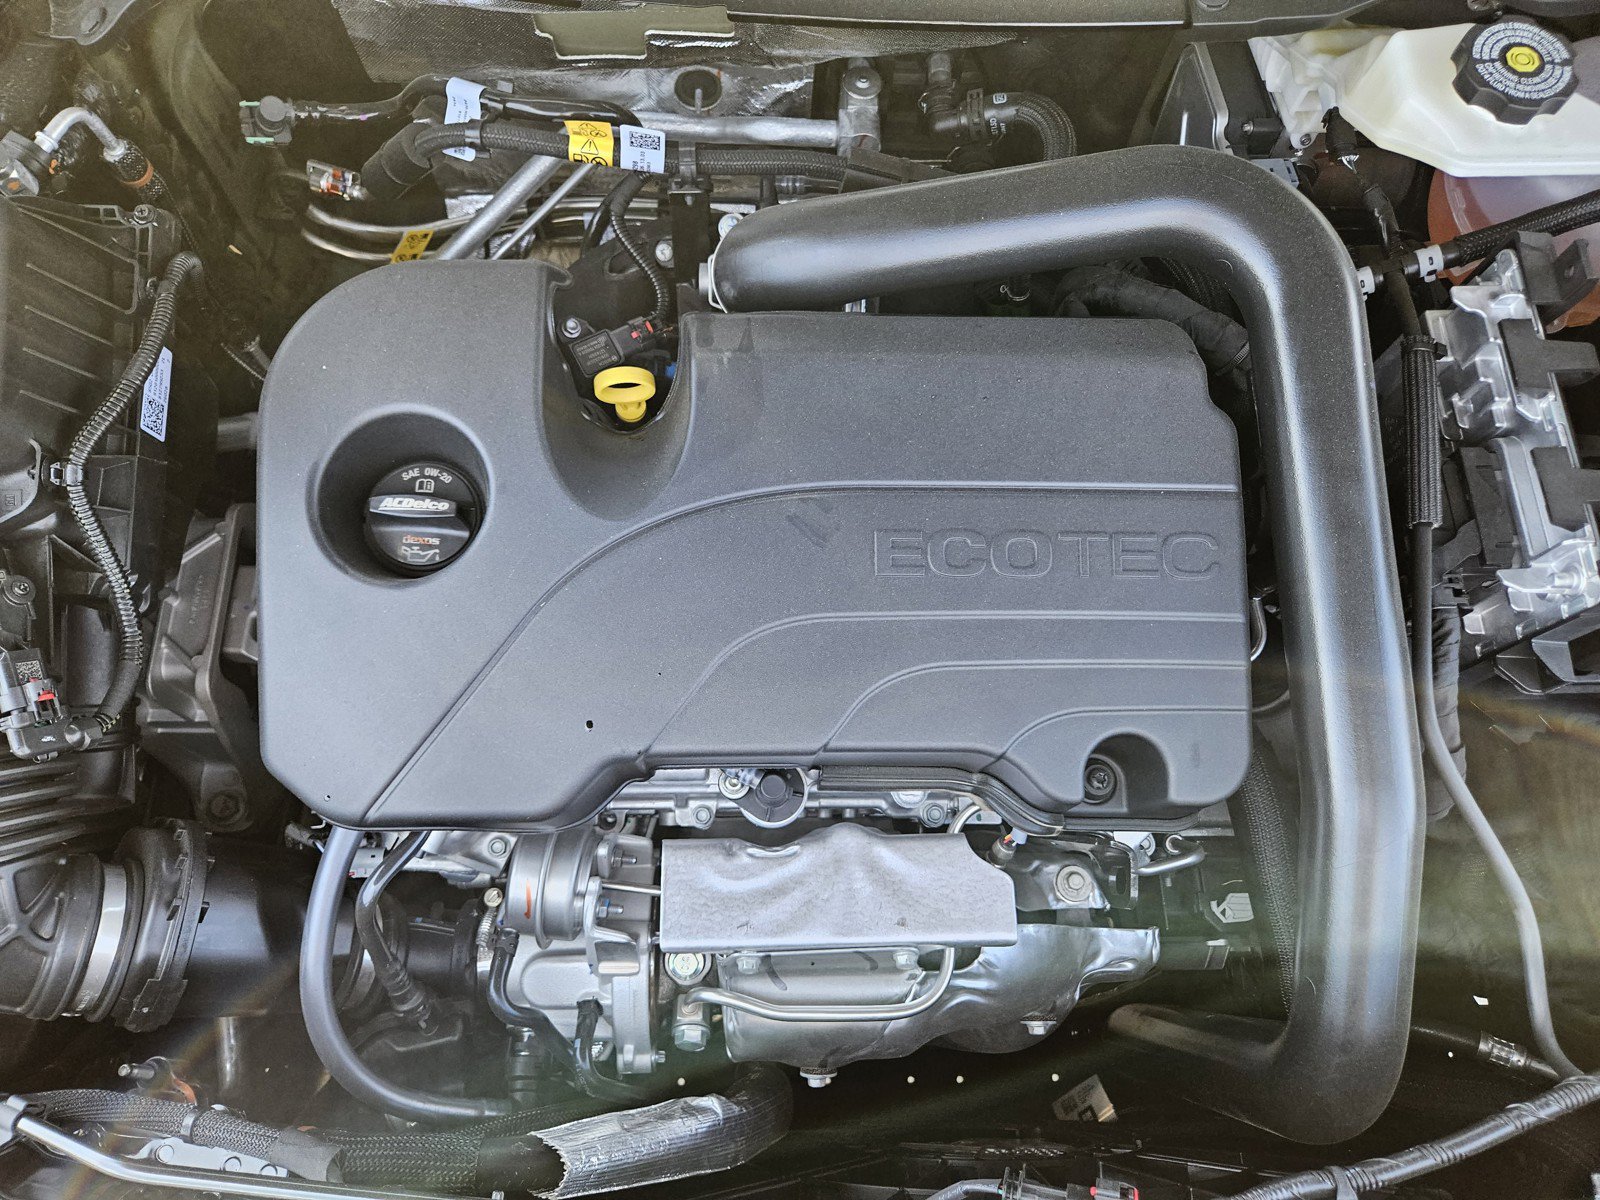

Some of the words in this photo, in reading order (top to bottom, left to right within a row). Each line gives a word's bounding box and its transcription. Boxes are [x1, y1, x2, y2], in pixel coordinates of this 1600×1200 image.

[402, 468, 421, 481] SAE
[424, 467, 453, 484] 0W-20
[378, 497, 450, 511] ACDelco
[402, 535, 441, 546] dexos
[874, 528, 1220, 580] ECOTEC
